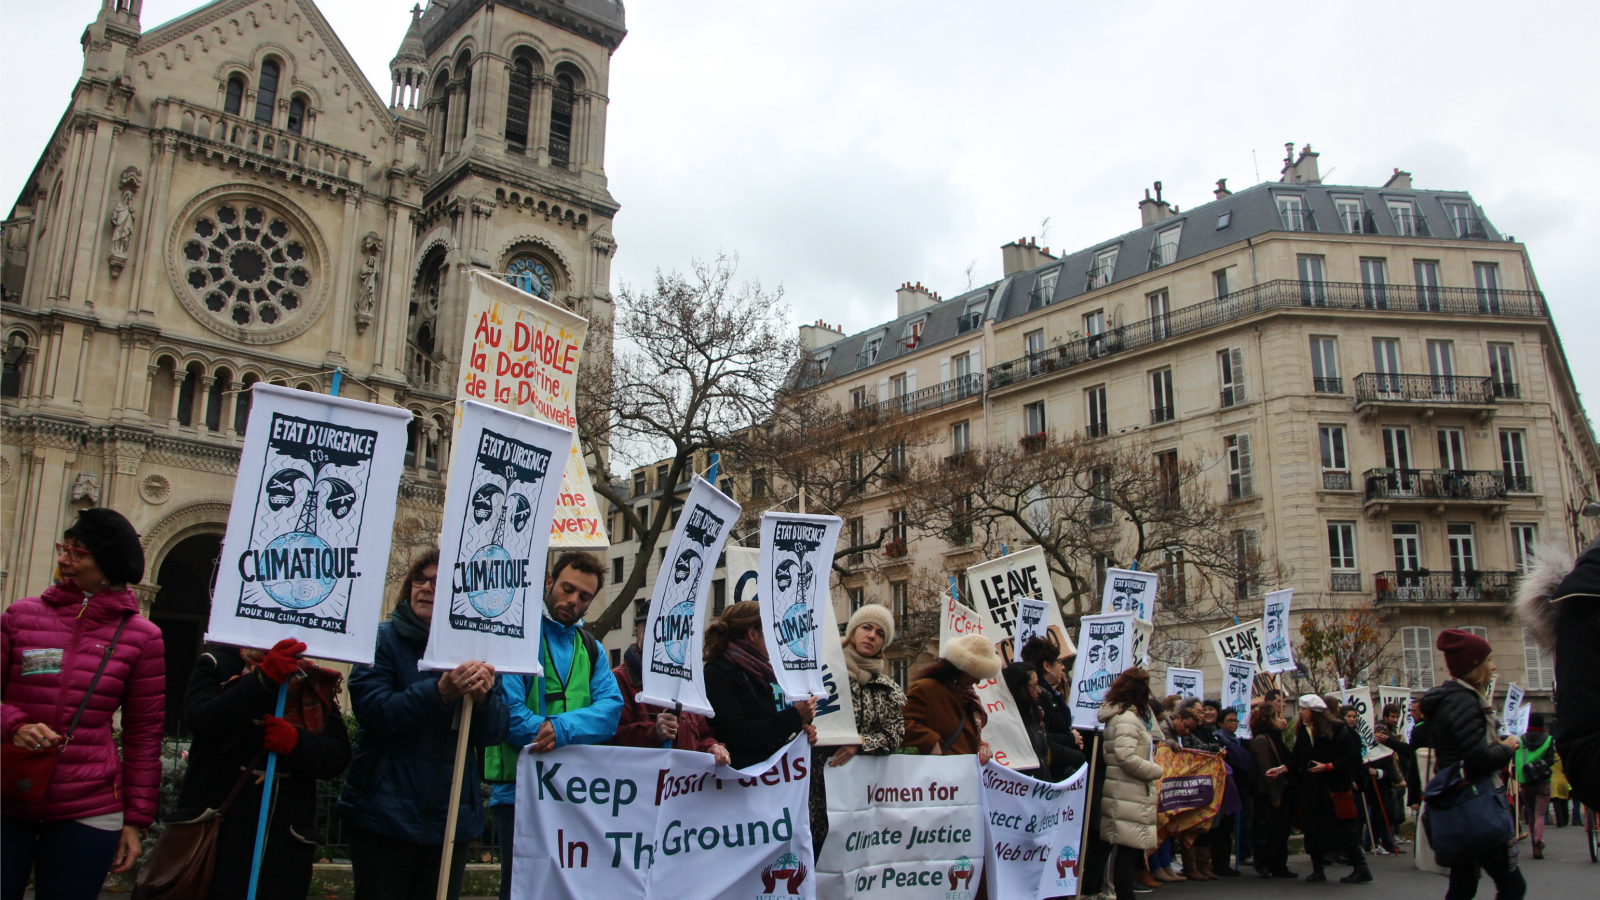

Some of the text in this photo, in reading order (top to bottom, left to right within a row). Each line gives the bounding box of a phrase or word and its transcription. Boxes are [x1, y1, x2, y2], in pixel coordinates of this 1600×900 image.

[474, 311, 578, 375] Au DIABLE
[470, 343, 560, 398] la Doctrine
[465, 373, 487, 399] de
[494, 379, 511, 404] la
[272, 417, 375, 455] ÉTAT D'URGENCE
[502, 441, 549, 474] D'URGENCE
[238, 547, 362, 583] CLIMATIQUE.
[452, 559, 531, 594] CLIMATIQUE.
[980, 565, 1042, 610] LEAVE
[240, 606, 342, 630] POUR UN CLIMAT DE PAIX
[454, 619, 468, 627] OUR
[990, 606, 1007, 624] IT
[1218, 627, 1261, 658] LEAVE
[535, 761, 638, 817] Keep
[928, 781, 958, 801] for
[557, 829, 589, 869] In
[662, 806, 793, 856] Ground
[845, 825, 971, 852] Climate Justice
[1024, 814, 1038, 833] &
[881, 868, 943, 889] Peace
